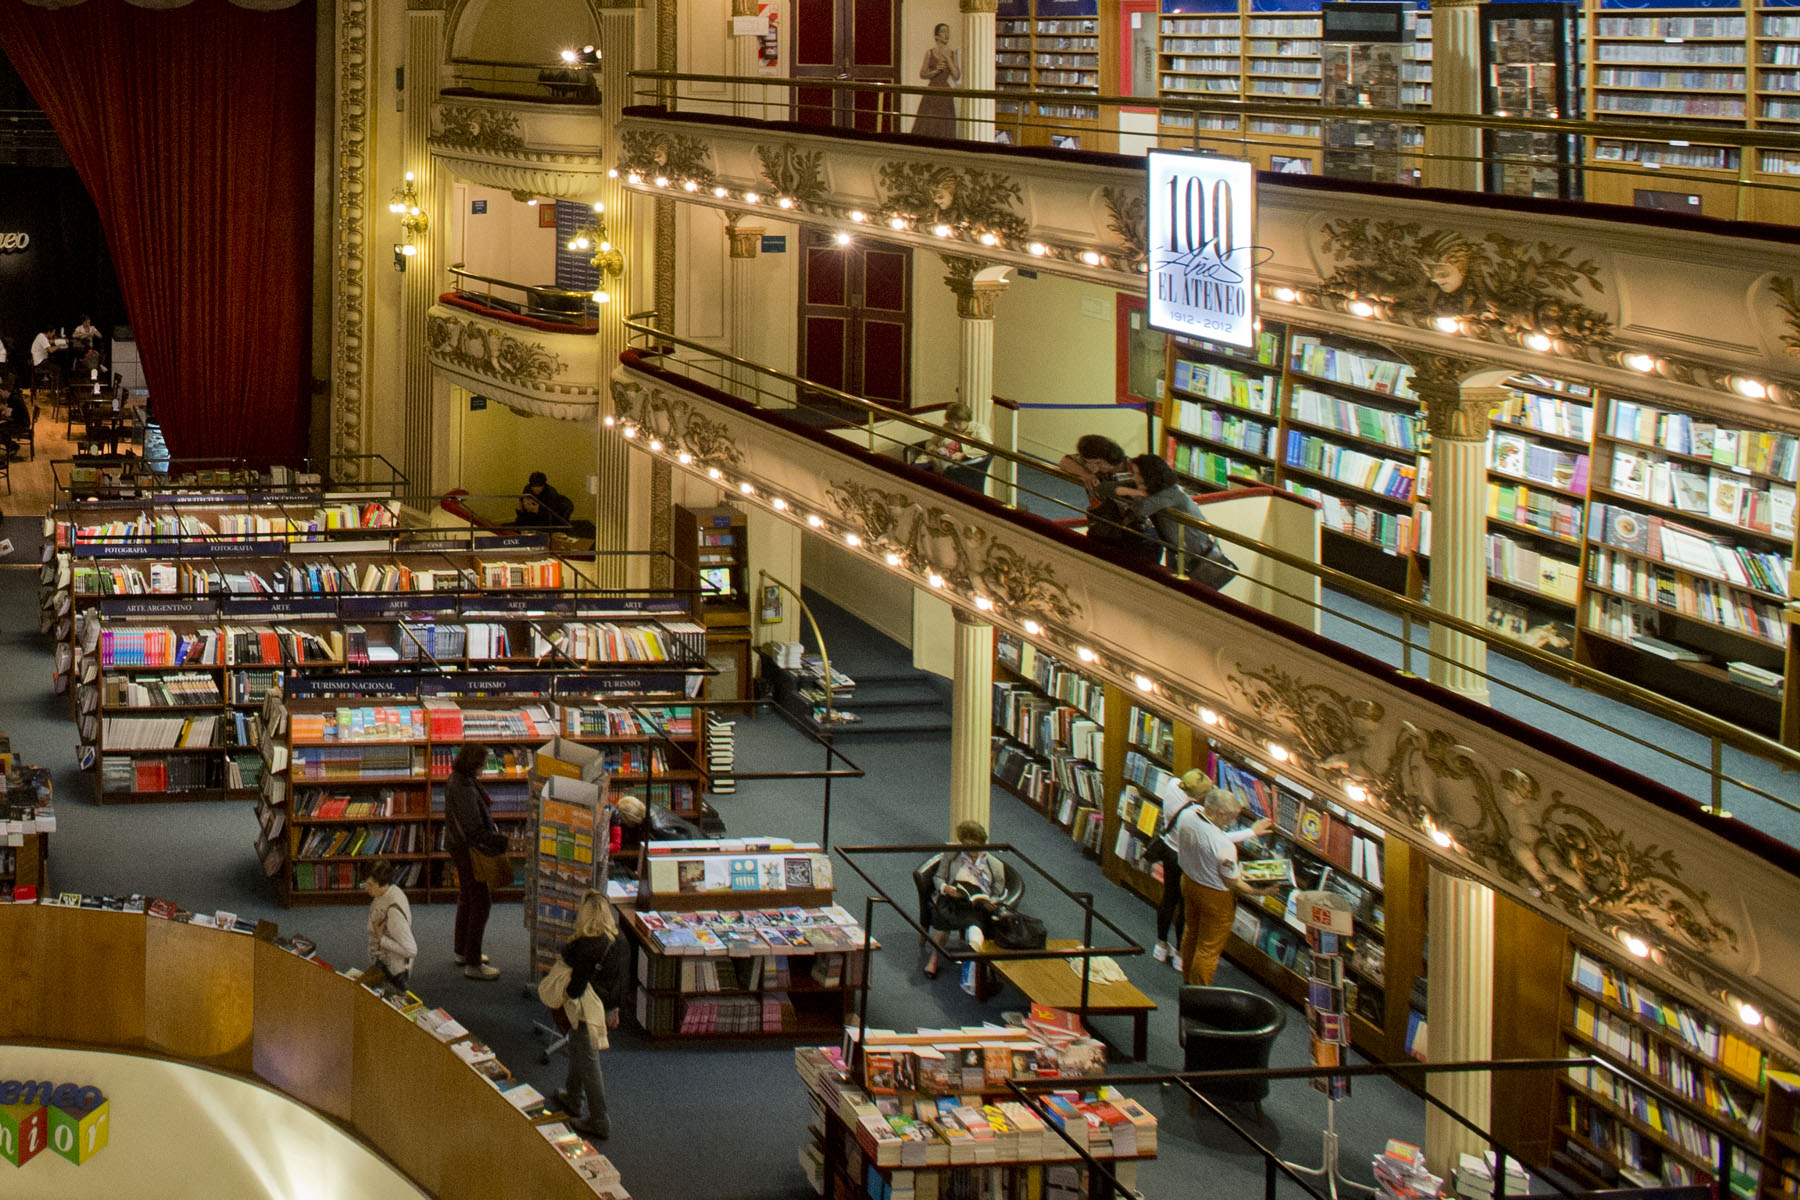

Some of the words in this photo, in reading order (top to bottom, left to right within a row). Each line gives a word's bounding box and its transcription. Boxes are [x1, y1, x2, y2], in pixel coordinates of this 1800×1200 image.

[1166, 175, 1234, 261] 100
[1158, 271, 1177, 303] EL
[1182, 277, 1246, 318] ATENEO
[104, 546, 148, 554] FOTOGRAFIA
[210, 544, 254, 552] FOTOGRAFIA
[147, 604, 193, 612] ARGENTINO
[271, 603, 291, 611] ARTE
[389, 600, 409, 608] ARTE
[508, 601, 528, 609] ARTE
[623, 601, 643, 609] ARTE
[310, 681, 350, 690] TURISMO
[351, 681, 396, 690] NACIONAL
[467, 680, 507, 689] TURISMO
[602, 679, 641, 688] TURISMO
